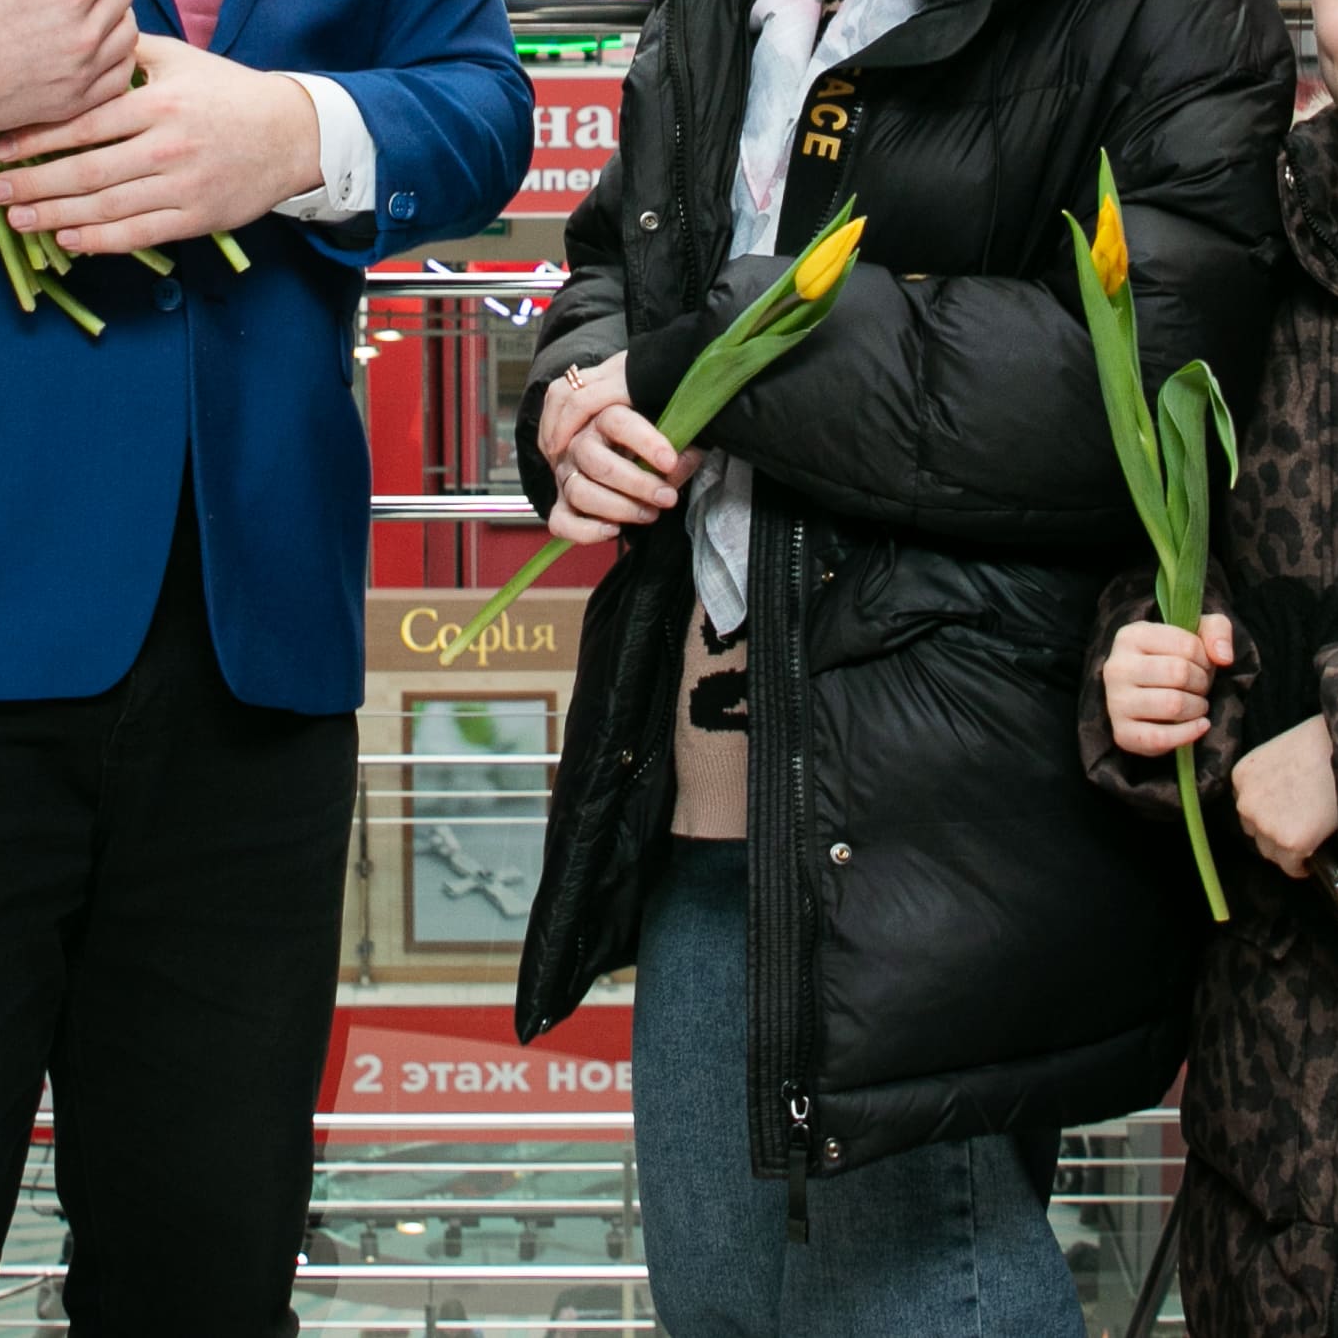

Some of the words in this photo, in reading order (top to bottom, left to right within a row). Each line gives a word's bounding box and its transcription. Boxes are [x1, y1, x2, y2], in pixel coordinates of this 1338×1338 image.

[533, 105, 620, 149] на
[802, 67, 861, 161] ACE
[400, 607, 557, 667] София
[352, 1053, 384, 1093] 2
[401, 1062, 531, 1092] этаж
